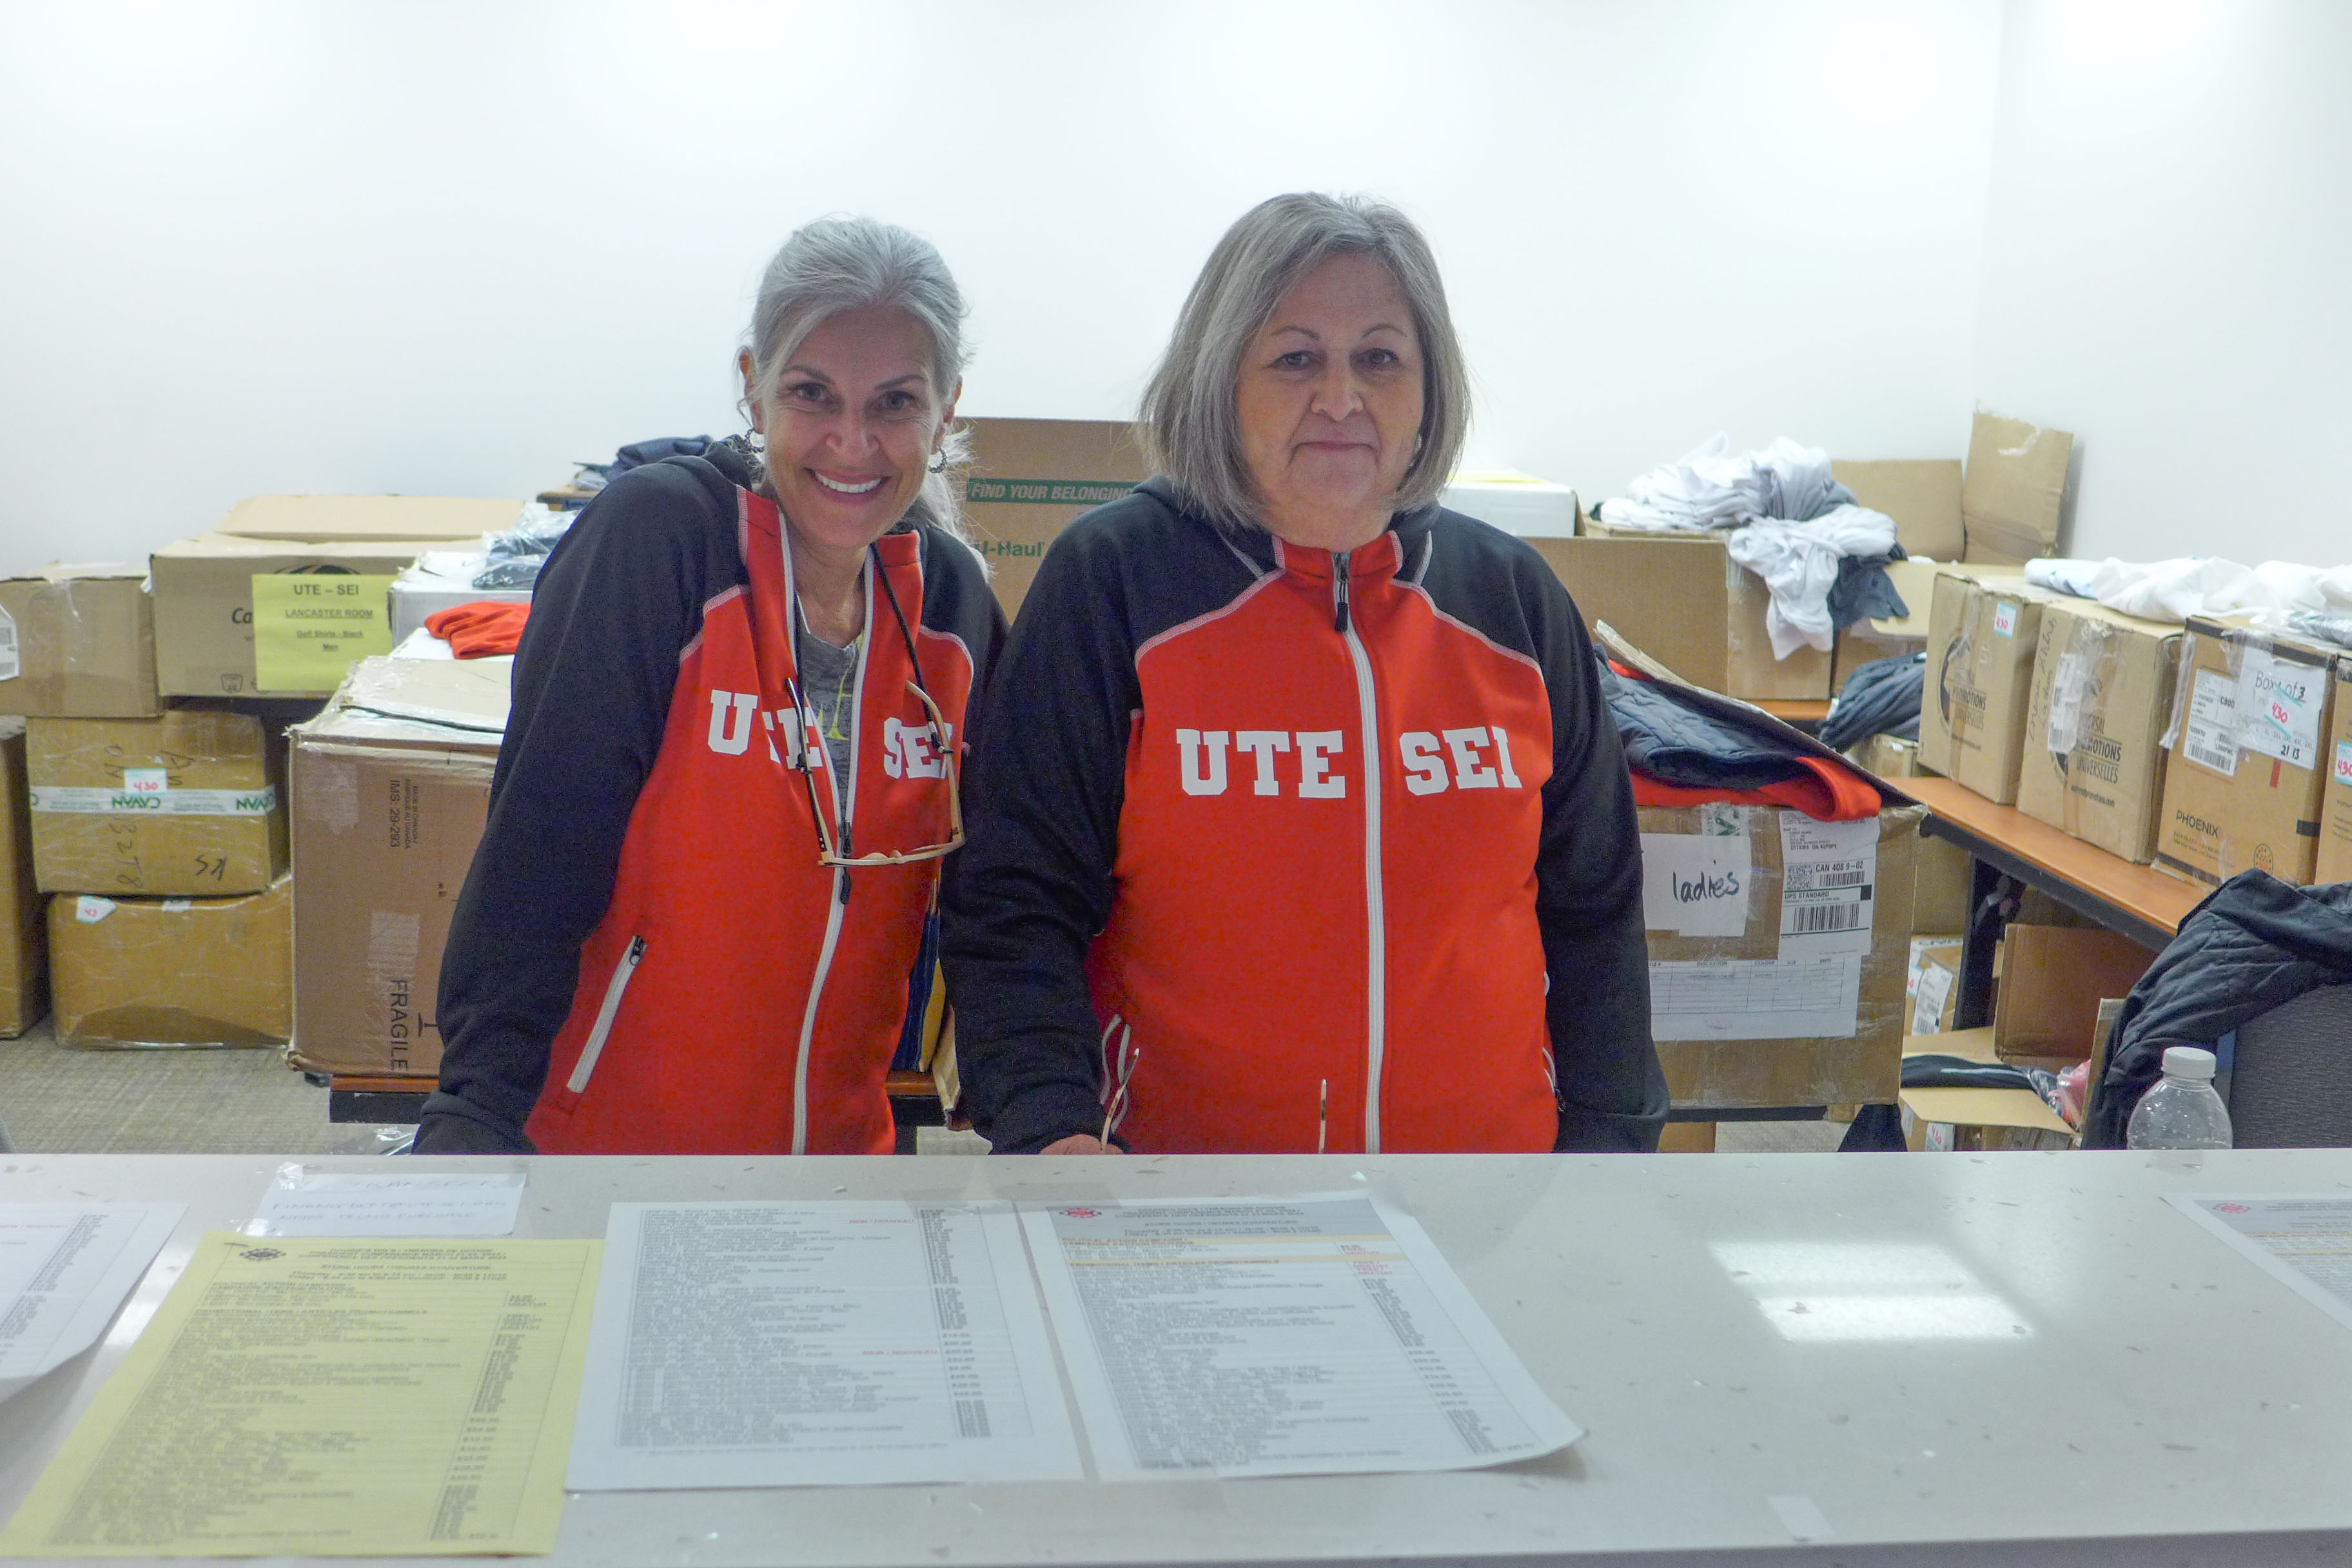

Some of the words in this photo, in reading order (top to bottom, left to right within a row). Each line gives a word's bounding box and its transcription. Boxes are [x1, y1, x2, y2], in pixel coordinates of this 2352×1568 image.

[970, 484, 1006, 499] FIND
[1010, 484, 1048, 500] YOUR
[294, 584, 321, 595] UTE
[337, 584, 359, 595] SEI
[285, 609, 342, 618] LANCASTER
[345, 609, 373, 618] ROOM
[343, 629, 364, 638] Black
[2255, 670, 2275, 691] Box
[2298, 685, 2306, 701] 3
[2271, 701, 2288, 724] 430
[1175, 728, 1346, 799] UTE
[1399, 725, 1523, 796] SEI
[2076, 755, 2119, 784] UNIVERSELLES
[133, 782, 159, 792] 430
[112, 796, 161, 809] CAVAN
[389, 808, 400, 847] 29-293
[2175, 809, 2219, 838] PHOENIX
[1816, 864, 1830, 872] CAN
[1832, 863, 1844, 871] 408
[1672, 859, 1740, 903] ladies
[391, 979, 408, 1071] FRAGILE
